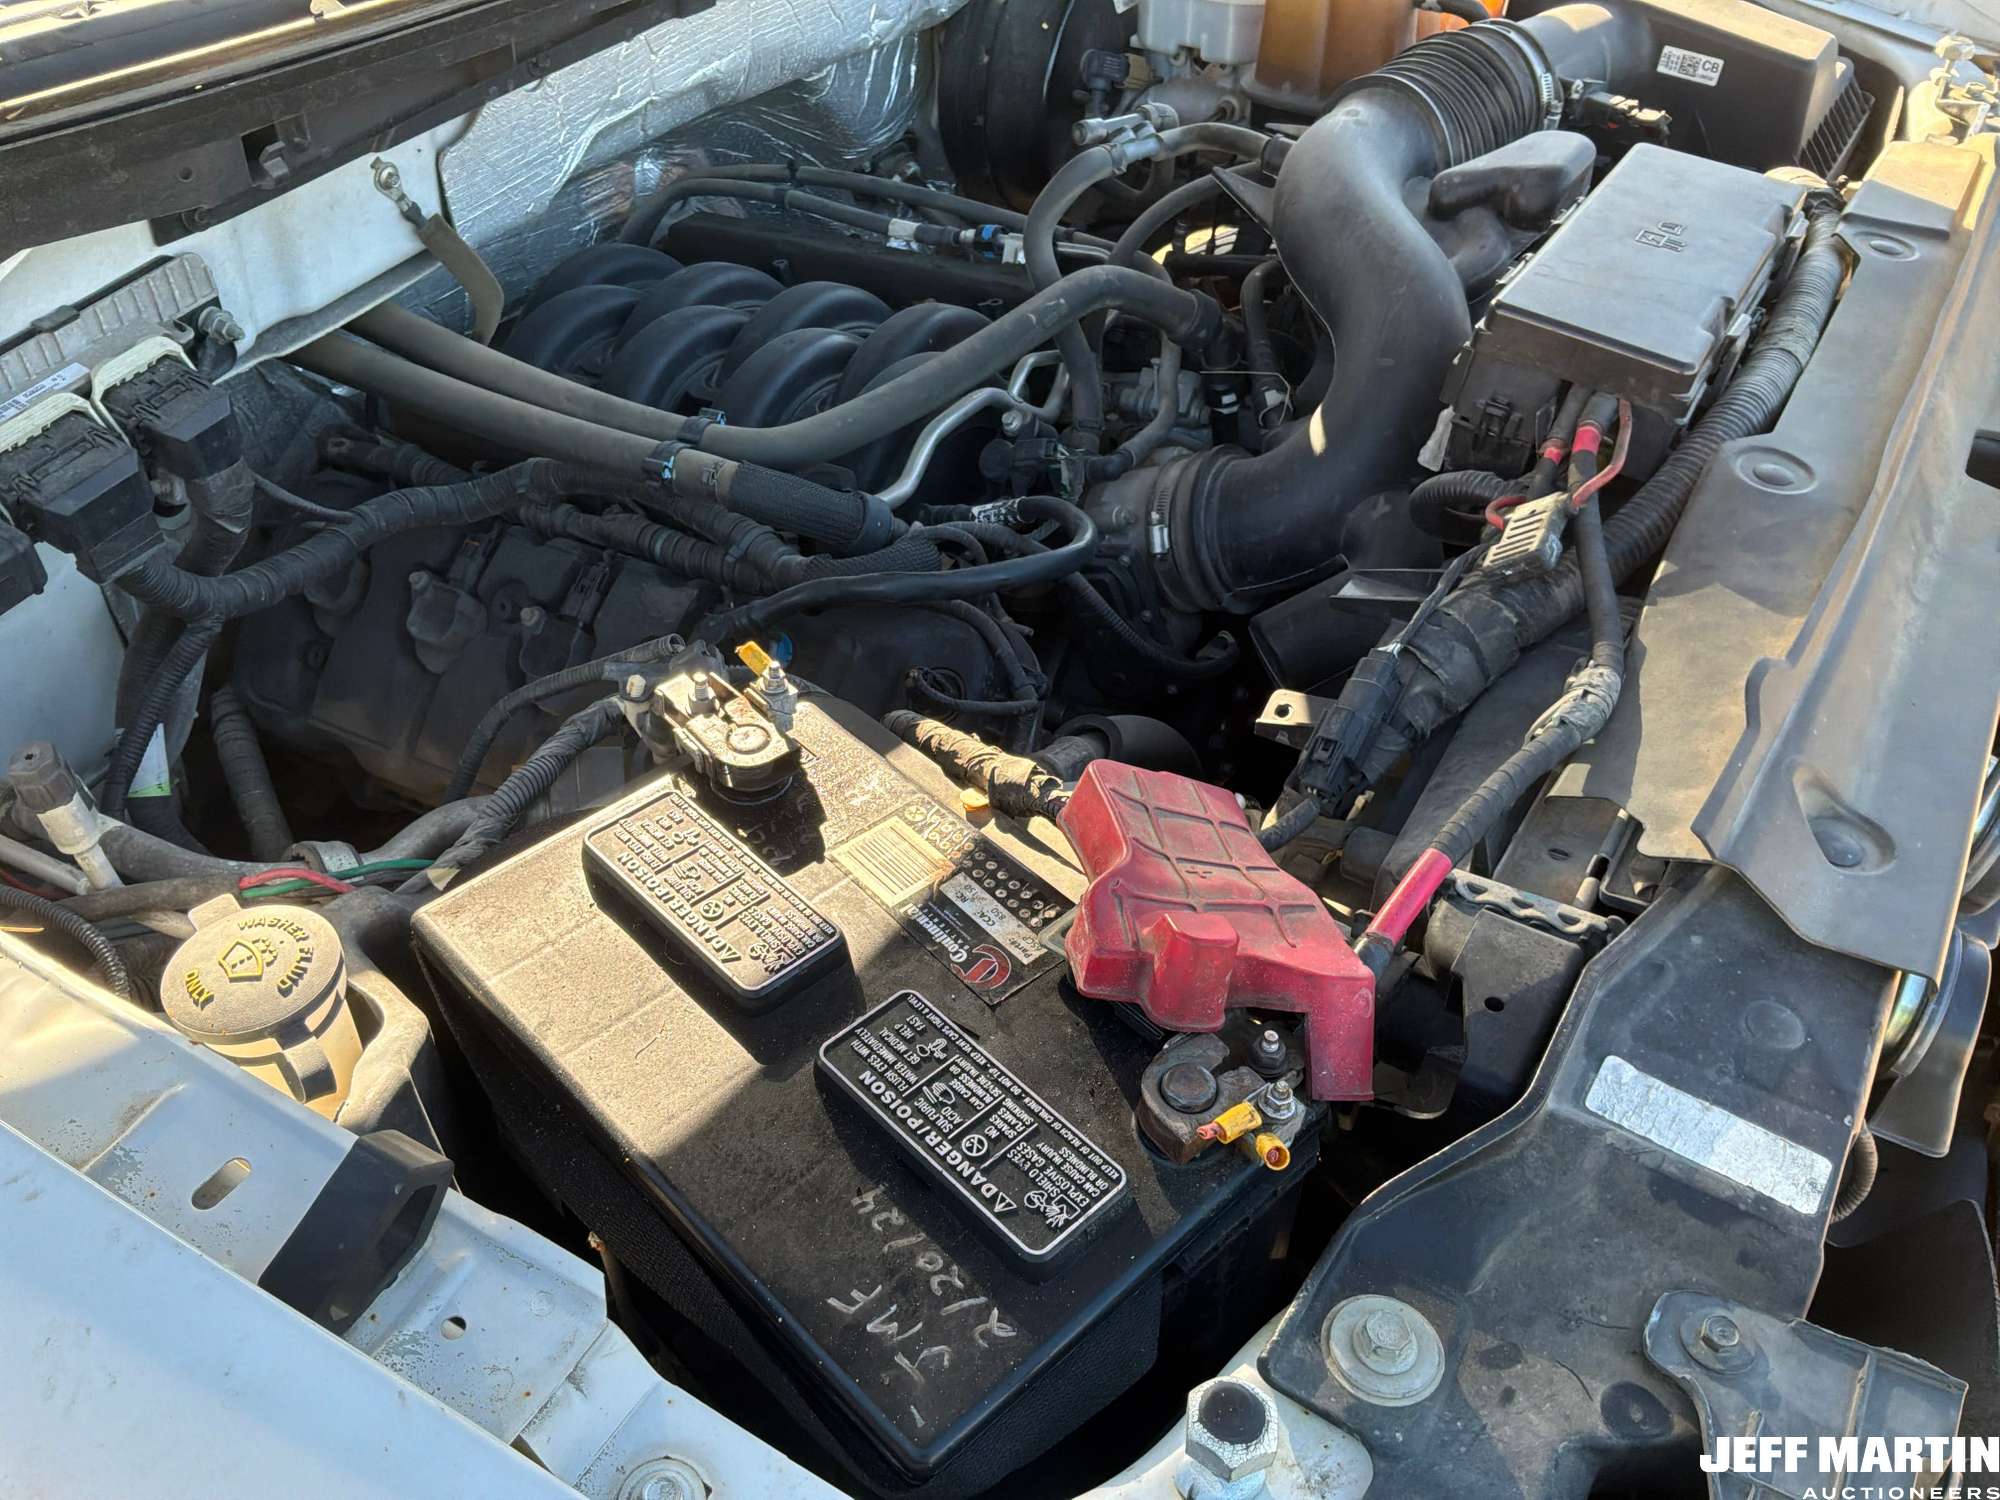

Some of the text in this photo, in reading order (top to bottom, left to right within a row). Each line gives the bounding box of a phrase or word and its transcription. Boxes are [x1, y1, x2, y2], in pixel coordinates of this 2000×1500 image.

[1702, 60, 1720, 73] CB
[952, 889, 969, 903] RC:
[962, 883, 979, 896] 150
[617, 849, 728, 951] DANGER/POISON
[976, 910, 996, 927] CCA:
[989, 906, 1006, 920] 850
[747, 906, 805, 954] EXPLOSIVE GASES
[898, 902, 968, 964] Continental
[919, 902, 970, 949] BATTERIES
[1007, 937, 1031, 958] Part#:
[185, 967, 214, 1005] ONLY
[905, 994, 925, 1010] LEVEL
[906, 1014, 925, 1029] FAST
[925, 1011, 945, 1027] TIGHT
[894, 1021, 914, 1038] HELP
[940, 1024, 959, 1040] CAPS
[854, 1026, 918, 1083] WATER IMMEDIATELY
[877, 1027, 921, 1065] GET MEDICAL
[955, 1037, 973, 1053] VENT
[850, 1039, 908, 1090] FLUSH EYES WITH
[969, 1049, 988, 1065] KEEP
[955, 1056, 1001, 1096] SEVERE INJURY
[988, 1065, 1002, 1078] TIP
[998, 1074, 1013, 1087] NOT
[947, 1063, 992, 1102] BLINDNESS OR
[1009, 1084, 1022, 1095] DO
[949, 1078, 985, 1110] CAN CAUSE
[913, 1097, 953, 1132] SULFURIC
[941, 1105, 963, 1124] ACID
[997, 1107, 1024, 1131] FLAMES
[1002, 1098, 1033, 1124] SMOKING
[1023, 1096, 1053, 1122] CHILDREN
[856, 1069, 1001, 1198] DANGER/POISON
[983, 1124, 1000, 1139] NO
[989, 1114, 1017, 1138] SPARKS
[1051, 1120, 1063, 1130] OF
[1060, 1128, 1081, 1146] REACH
[1078, 1144, 1090, 1154] OF
[1087, 1151, 1104, 1166] OUT
[1006, 1148, 1060, 1196] SHIELD EYES
[1015, 1141, 1089, 1206] EXPLOSIVE GASES
[1036, 1140, 1100, 1197] CAN CAUSE INJURY
[1058, 1147, 1109, 1191] OR BLINDNESS
[1100, 1163, 1119, 1179] KEEP
